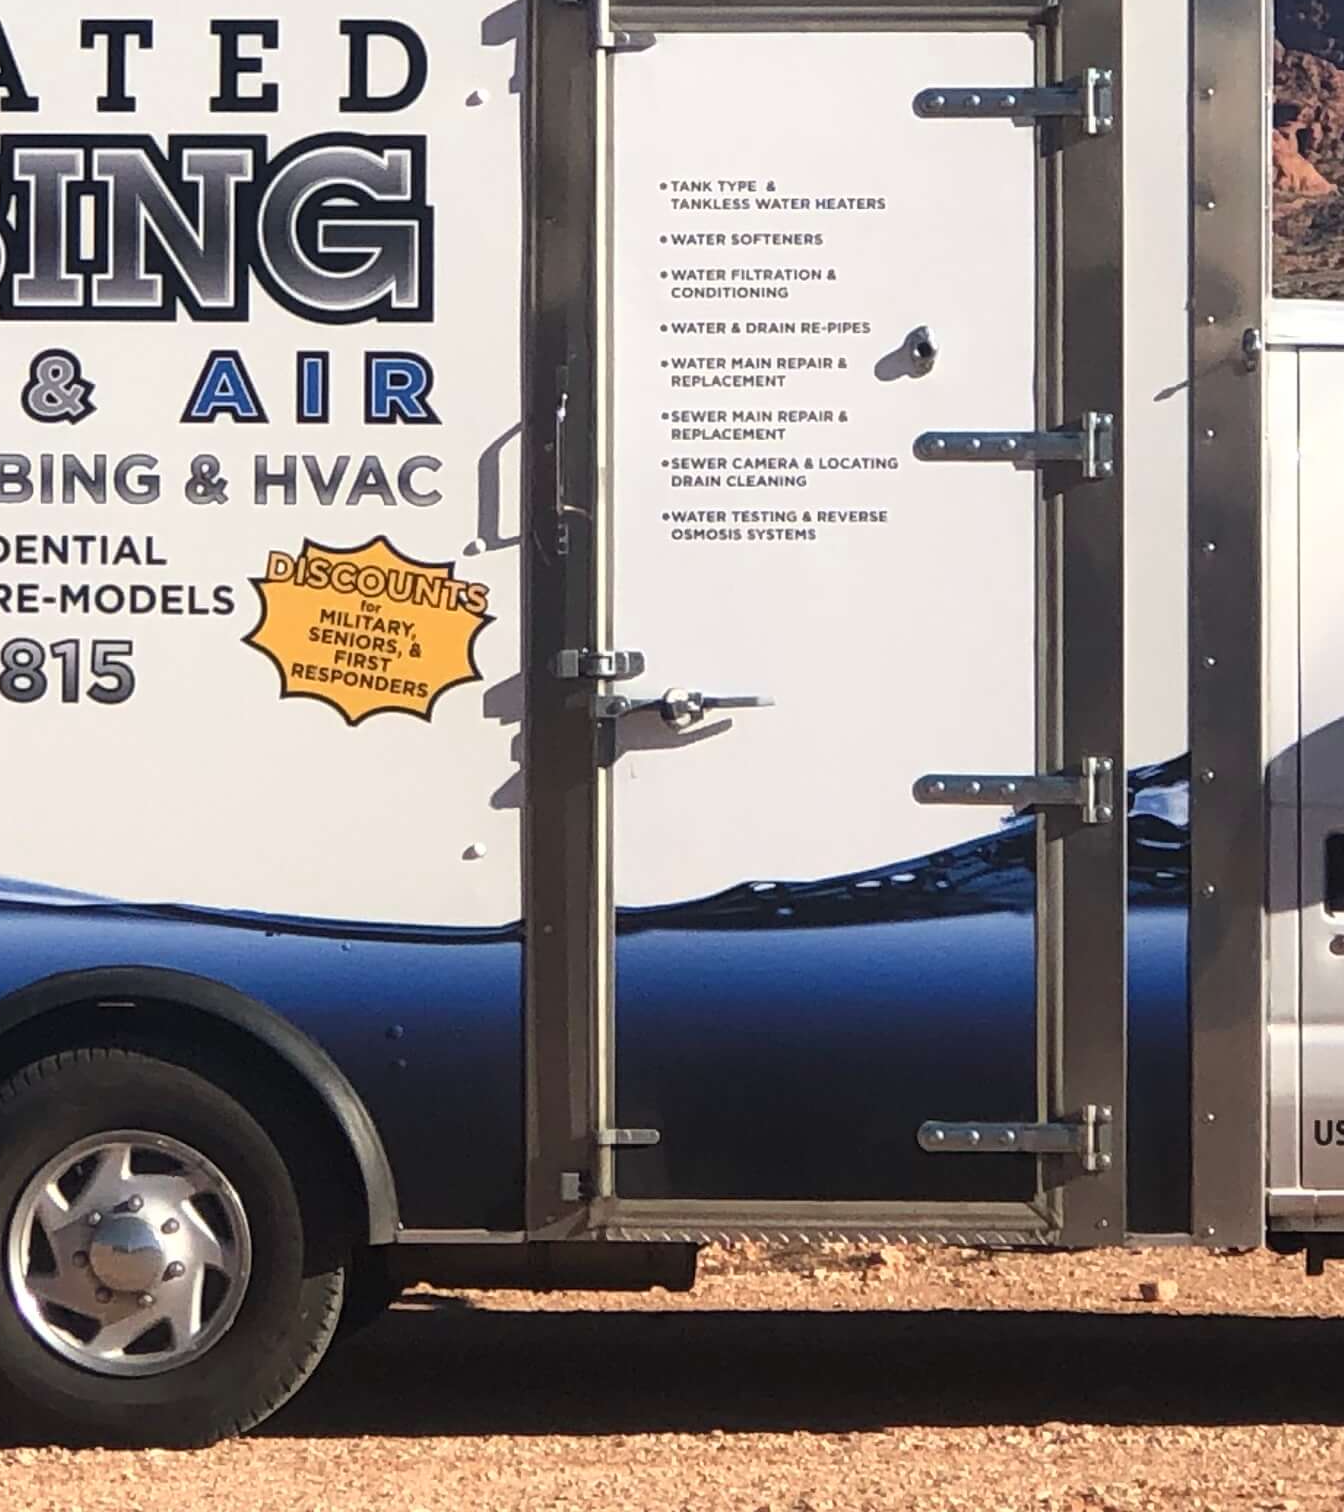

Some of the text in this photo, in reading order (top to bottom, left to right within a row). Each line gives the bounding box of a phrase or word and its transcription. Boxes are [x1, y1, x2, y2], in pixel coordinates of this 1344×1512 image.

[671, 181, 776, 192] TANK TYPE &
[671, 198, 886, 209] TANKLESS WATER HEATERS
[671, 234, 823, 245] WATER SOFTENERS
[671, 269, 836, 280] WATER FILTRATION &
[671, 287, 788, 298] CONDITIONING
[671, 323, 871, 334] WATER & DRAIN RE-PIPES
[671, 358, 848, 369] WATER MAIN REPAIR &
[671, 376, 786, 387] REPLACEMENT
[21, 348, 97, 426] &
[179, 349, 443, 427] AIR
[671, 411, 848, 422] SEWER MAIN REPAIR &
[671, 429, 786, 440] REPLACEMENT
[671, 458, 898, 469] SEWER CAMERA & LOCATING
[184, 453, 230, 507] &
[254, 453, 443, 508] HVAC
[671, 476, 807, 487] DRAIN CLEANING
[671, 511, 887, 522] WATER TESTING & REVERSE
[671, 529, 816, 540] OSMOSIS SYSTEMS
[266, 551, 489, 614] DISCOUNTS
[360, 600, 382, 614] for
[308, 627, 422, 659] SENIORS, &
[334, 649, 392, 673] FIRST
[290, 662, 429, 699] RESPONDERS
